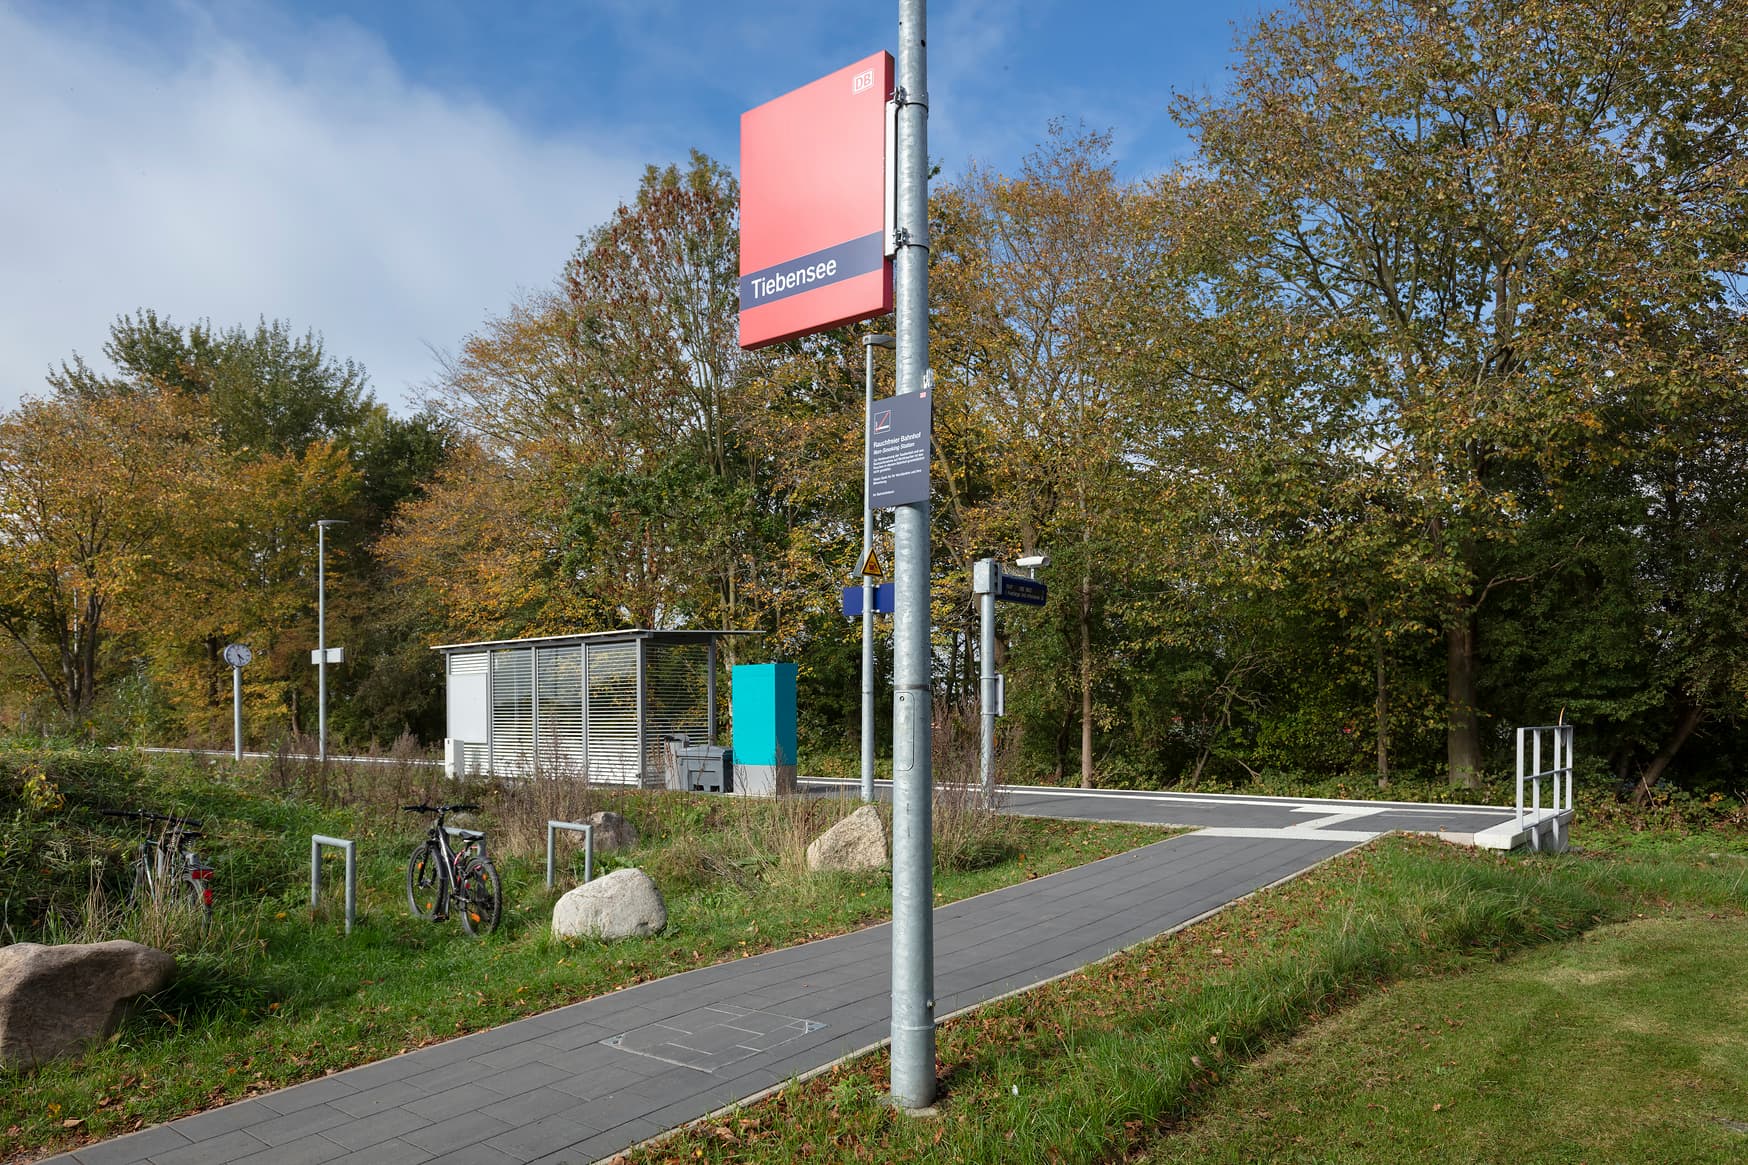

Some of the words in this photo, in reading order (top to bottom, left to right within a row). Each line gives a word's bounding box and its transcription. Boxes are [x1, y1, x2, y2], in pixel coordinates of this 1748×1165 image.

[854, 71, 872, 91] DB
[751, 259, 837, 299] Tiebensee
[901, 432, 921, 442] Bahnhof
